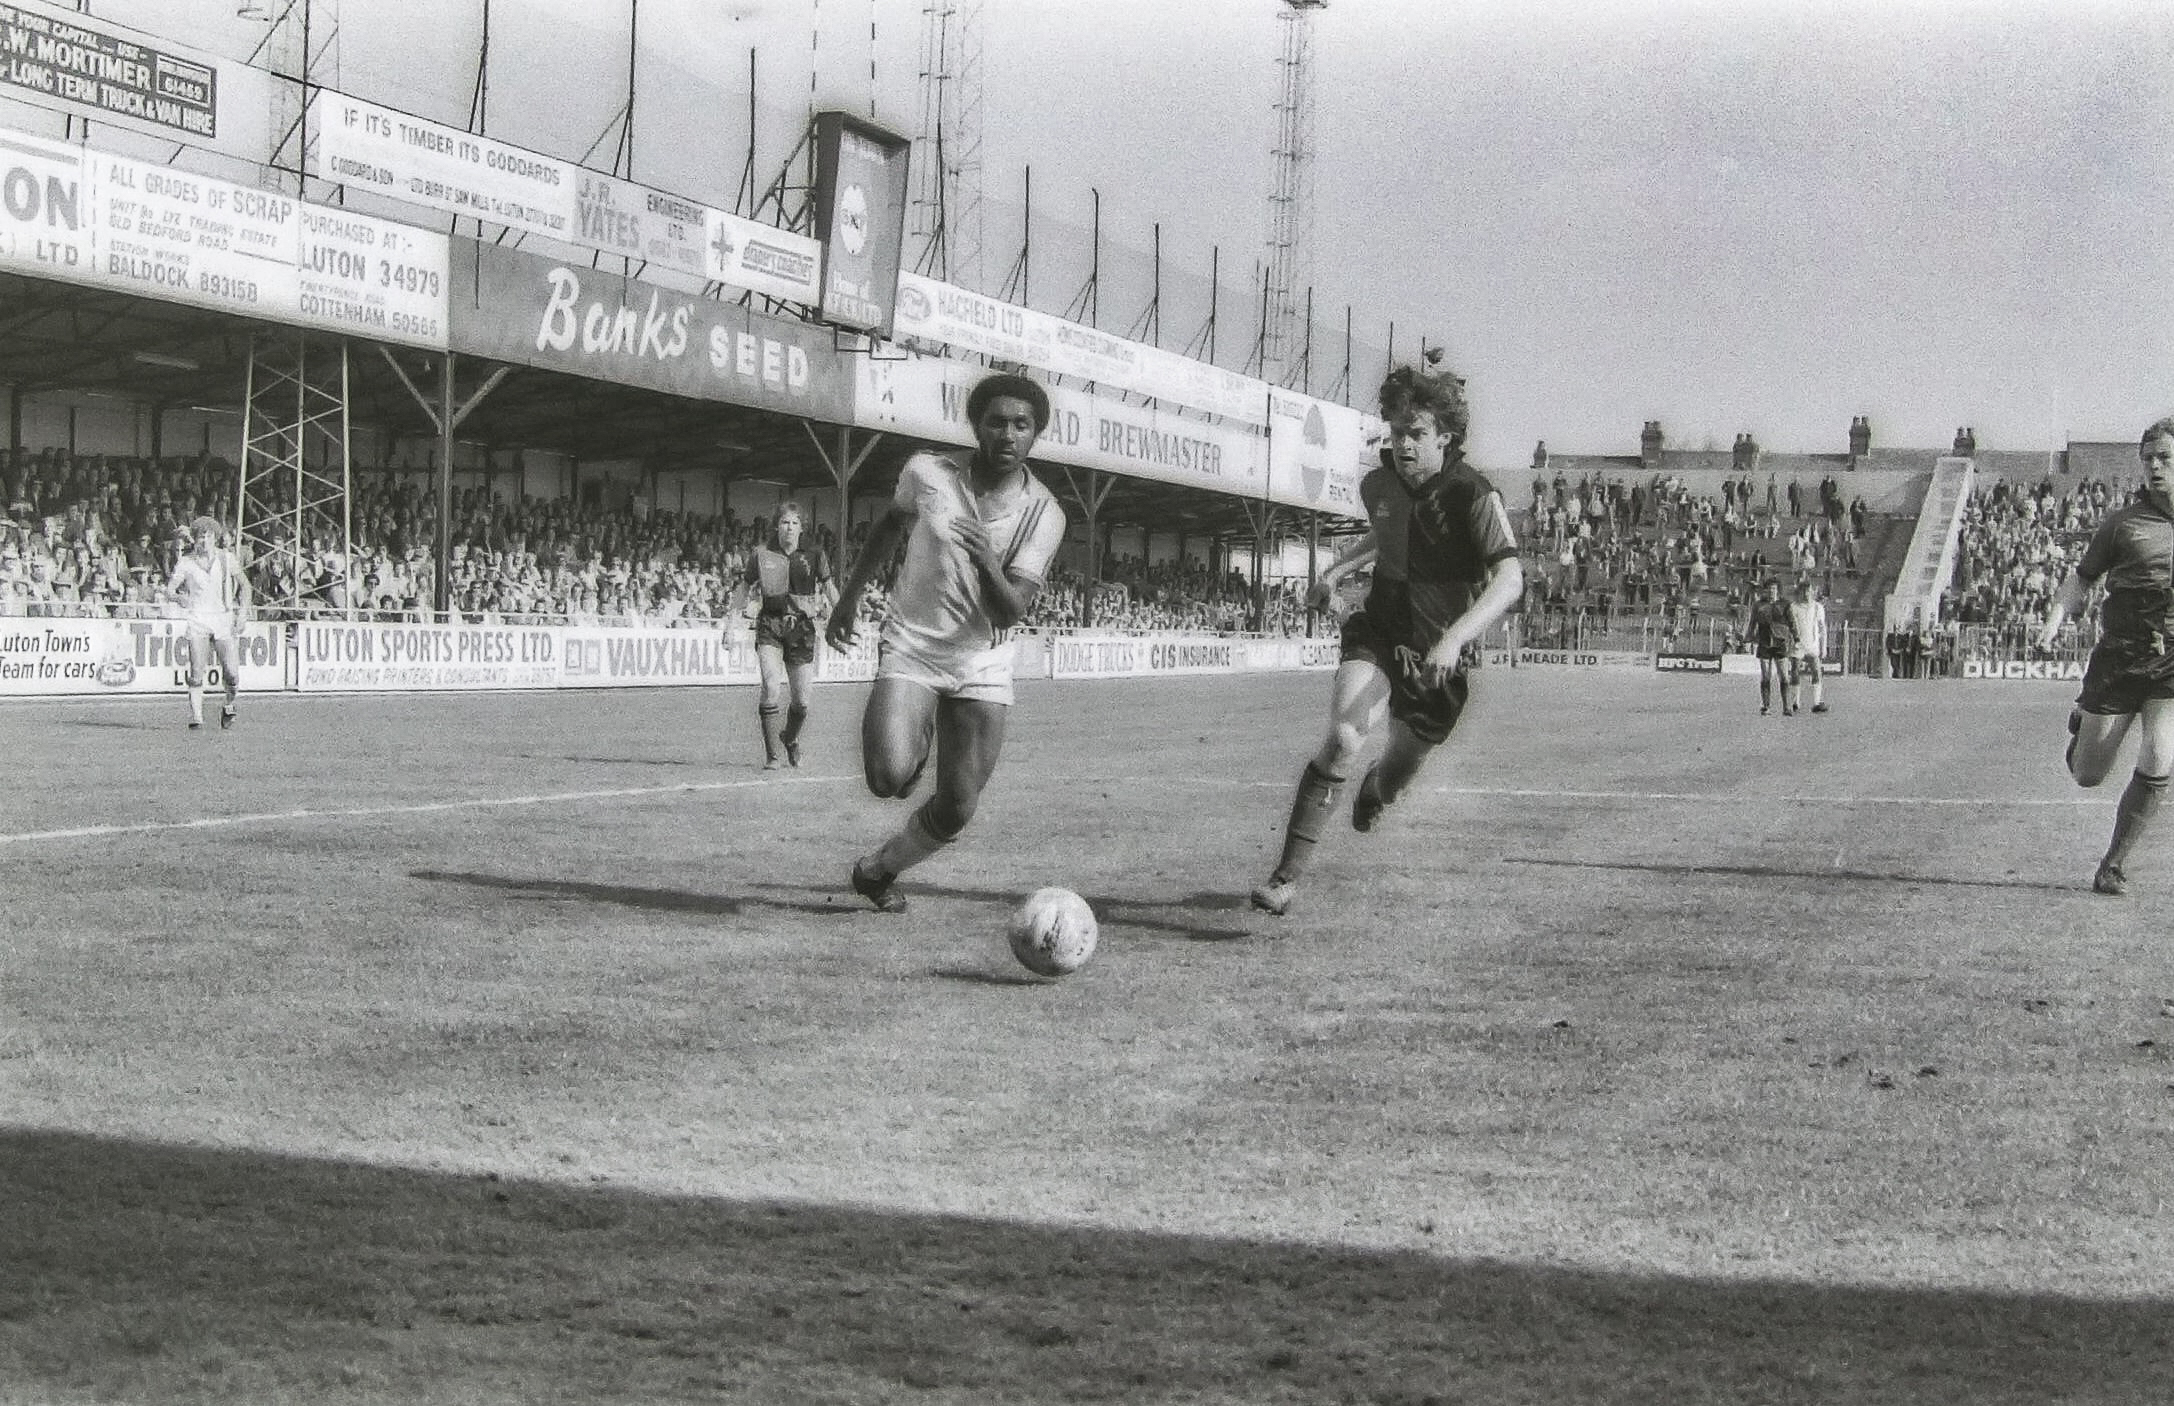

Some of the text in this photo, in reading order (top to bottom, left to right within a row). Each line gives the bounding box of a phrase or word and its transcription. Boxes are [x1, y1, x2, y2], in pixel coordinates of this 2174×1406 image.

[37, 35, 151, 90] MORTIMER
[11, 58, 52, 90] LONG
[56, 72, 98, 106] TERM
[344, 107, 358, 127] IF
[399, 123, 454, 156] TIMBER
[486, 150, 561, 186] GODDARDS
[109, 164, 292, 225] ALL GRADES OF SCRAP
[303, 211, 375, 245] PURCHASED
[578, 199, 640, 249] YATES
[36, 238, 79, 266] LTD
[109, 252, 191, 290] BALDOCK
[302, 243, 440, 298] LUTON 34979
[299, 293, 387, 329] COTTENHAM
[710, 324, 809, 388] SEED
[1099, 418, 1222, 476] BREWMASTER
[0, 632, 40, 653] uton
[305, 628, 374, 663] LUTON
[381, 629, 453, 663] SPORTS
[458, 630, 514, 663] PRESS
[607, 637, 724, 677] VAUXHALL
[1151, 643, 1231, 669] CIS INSURANCE
[1522, 653, 1569, 665] MEADE
[1574, 654, 1598, 666] LTD
[38, 656, 60, 679] for
[64, 660, 96, 680] cars
[1963, 660, 2083, 679] DUCKHA
